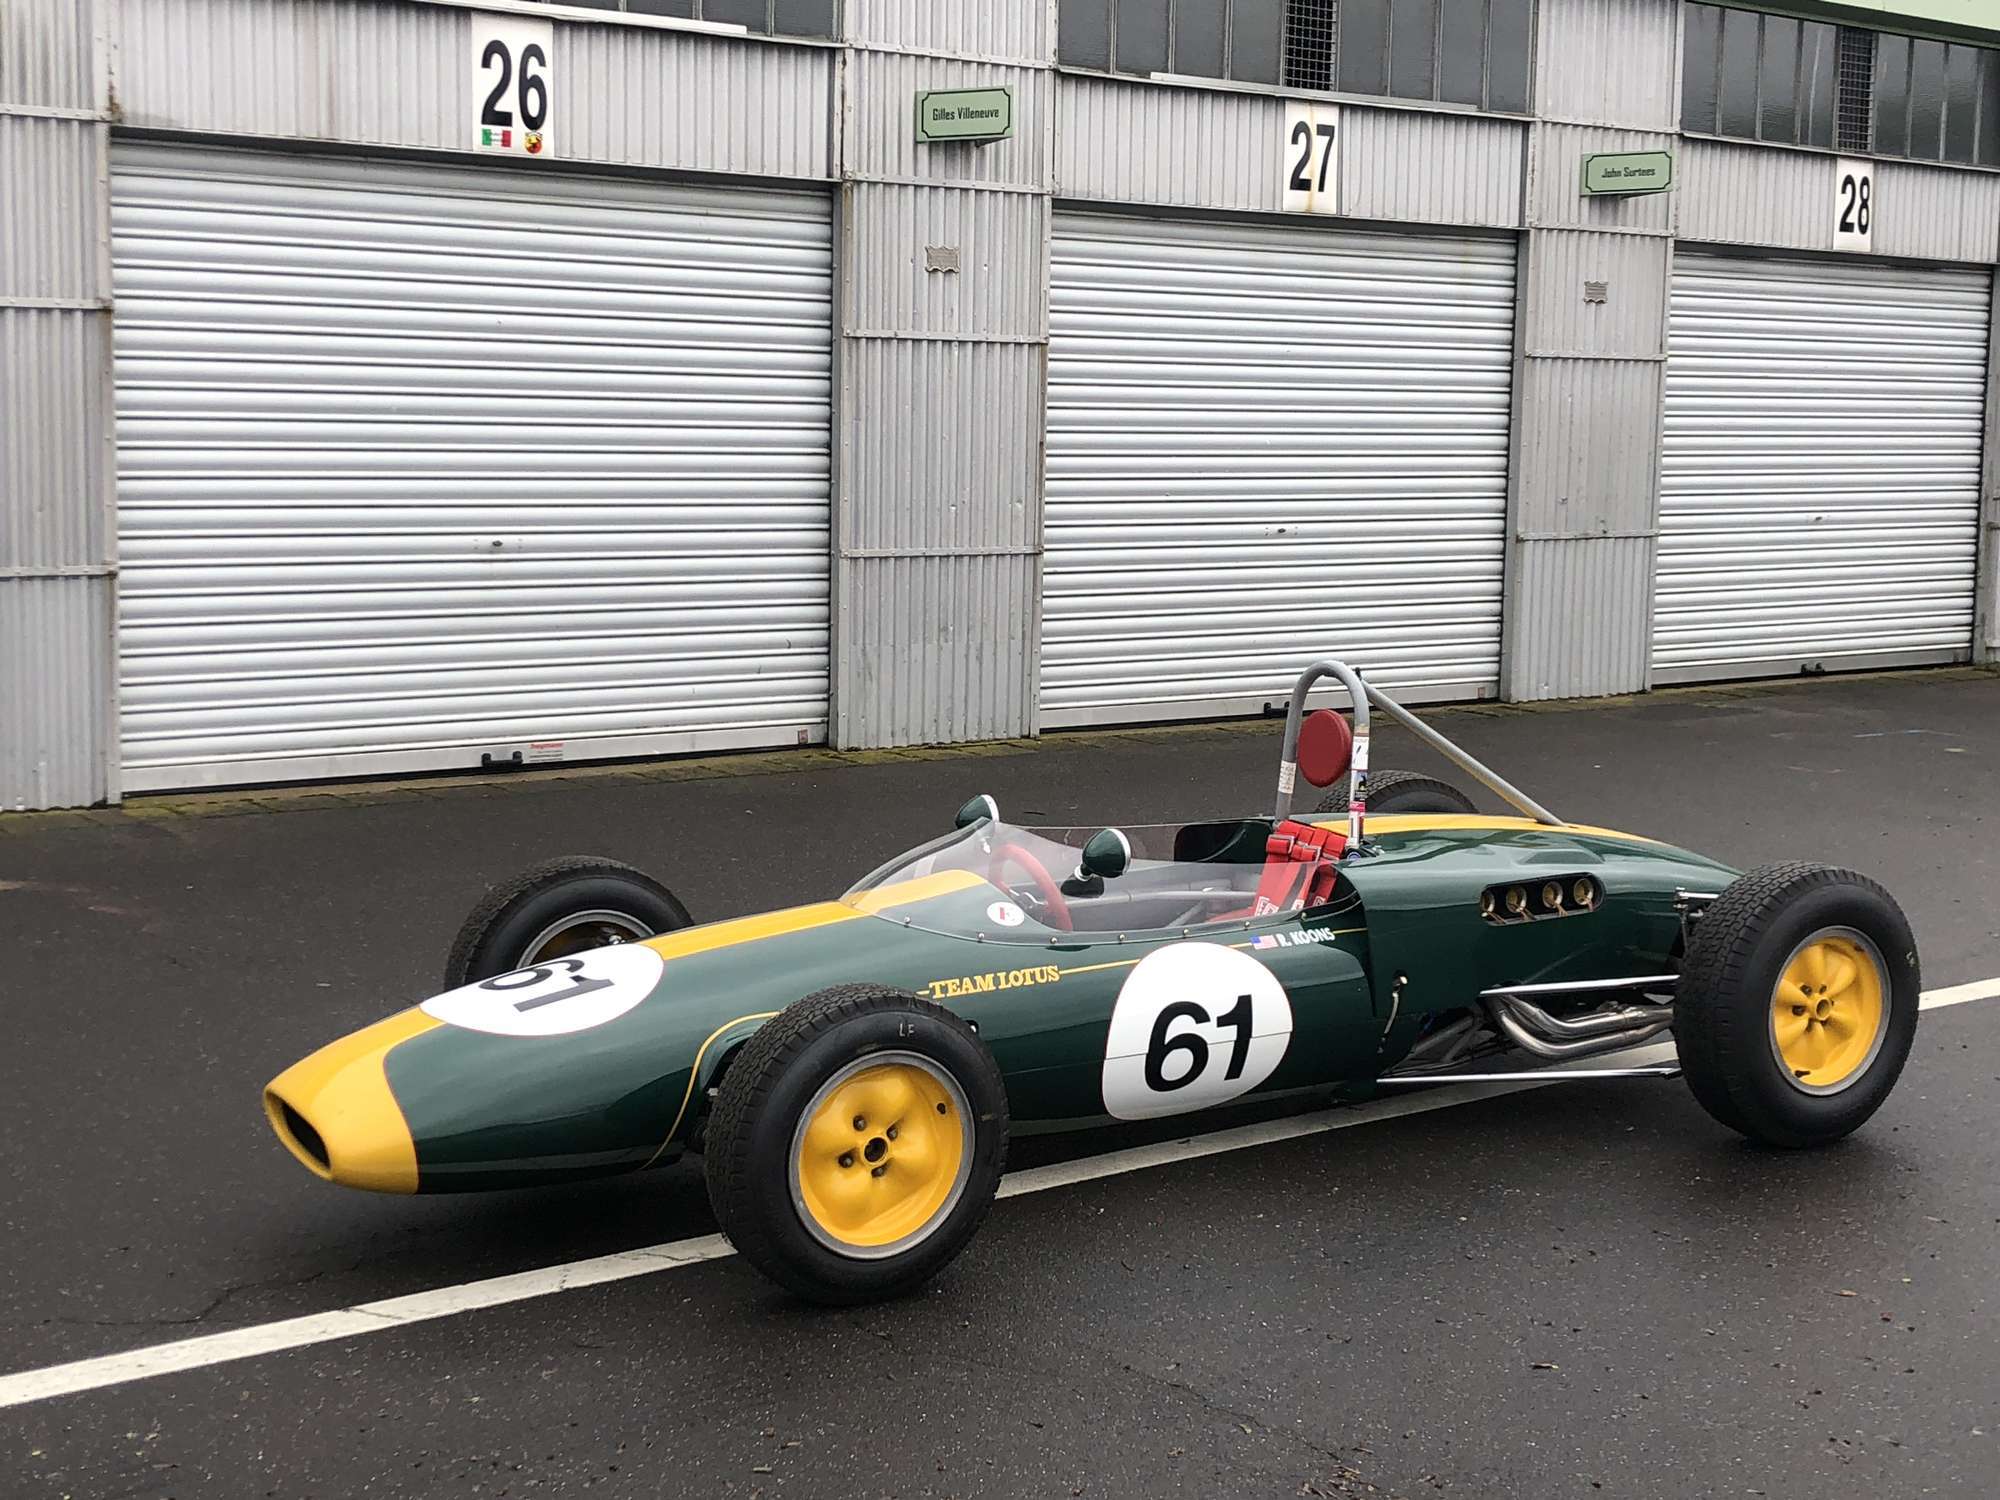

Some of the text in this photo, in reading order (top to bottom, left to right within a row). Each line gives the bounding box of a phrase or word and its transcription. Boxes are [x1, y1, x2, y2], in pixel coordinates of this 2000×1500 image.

[481, 39, 548, 131] 26
[932, 106, 1000, 121] Gilles Villeneuve
[1289, 120, 1336, 193] 27
[1601, 167, 1622, 178] John
[1839, 174, 1871, 235] 28
[1289, 927, 1335, 945] KOONS
[478, 959, 615, 1013] 61
[928, 965, 1061, 999] TEAM LOTUS
[899, 1023, 915, 1038] LF
[1144, 994, 1253, 1093] 61
